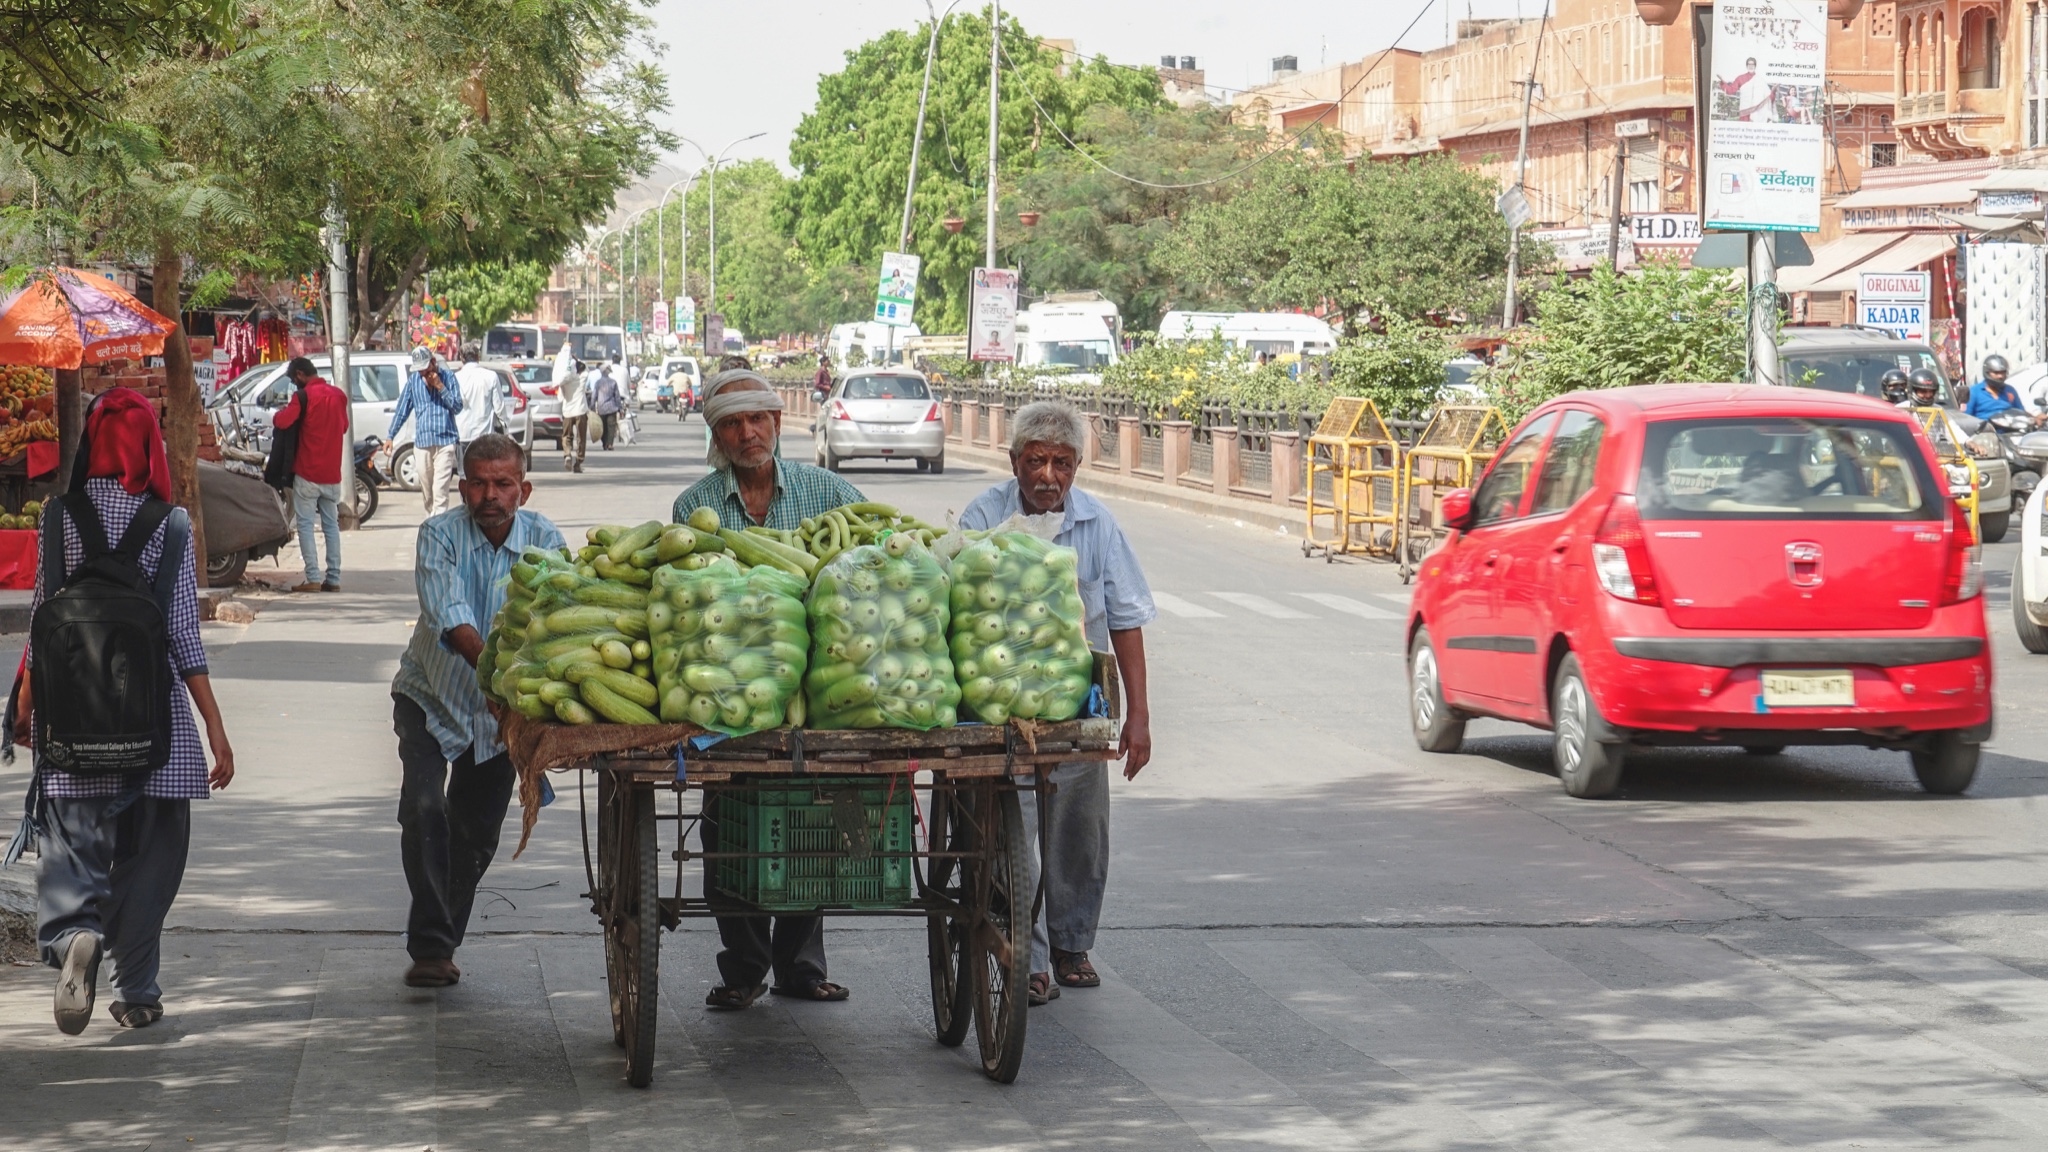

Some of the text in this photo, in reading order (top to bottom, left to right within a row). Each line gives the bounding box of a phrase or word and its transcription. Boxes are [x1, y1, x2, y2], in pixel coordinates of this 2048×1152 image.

[1738, 7, 1751, 15] सब
[1759, 170, 1816, 188] सर्वेक्षण
[1667, 191, 1685, 205] हाउस
[1844, 208, 1898, 226] PANPALIYA
[1867, 278, 1922, 293] ORIGINAL
[1867, 307, 1920, 324] KADAR
[96, 344, 111, 358] चलो
[112, 342, 128, 355] आगे
[83, 742, 109, 751] International
[109, 742, 124, 752] College
[124, 742, 132, 750] For
[132, 740, 152, 749] Education
